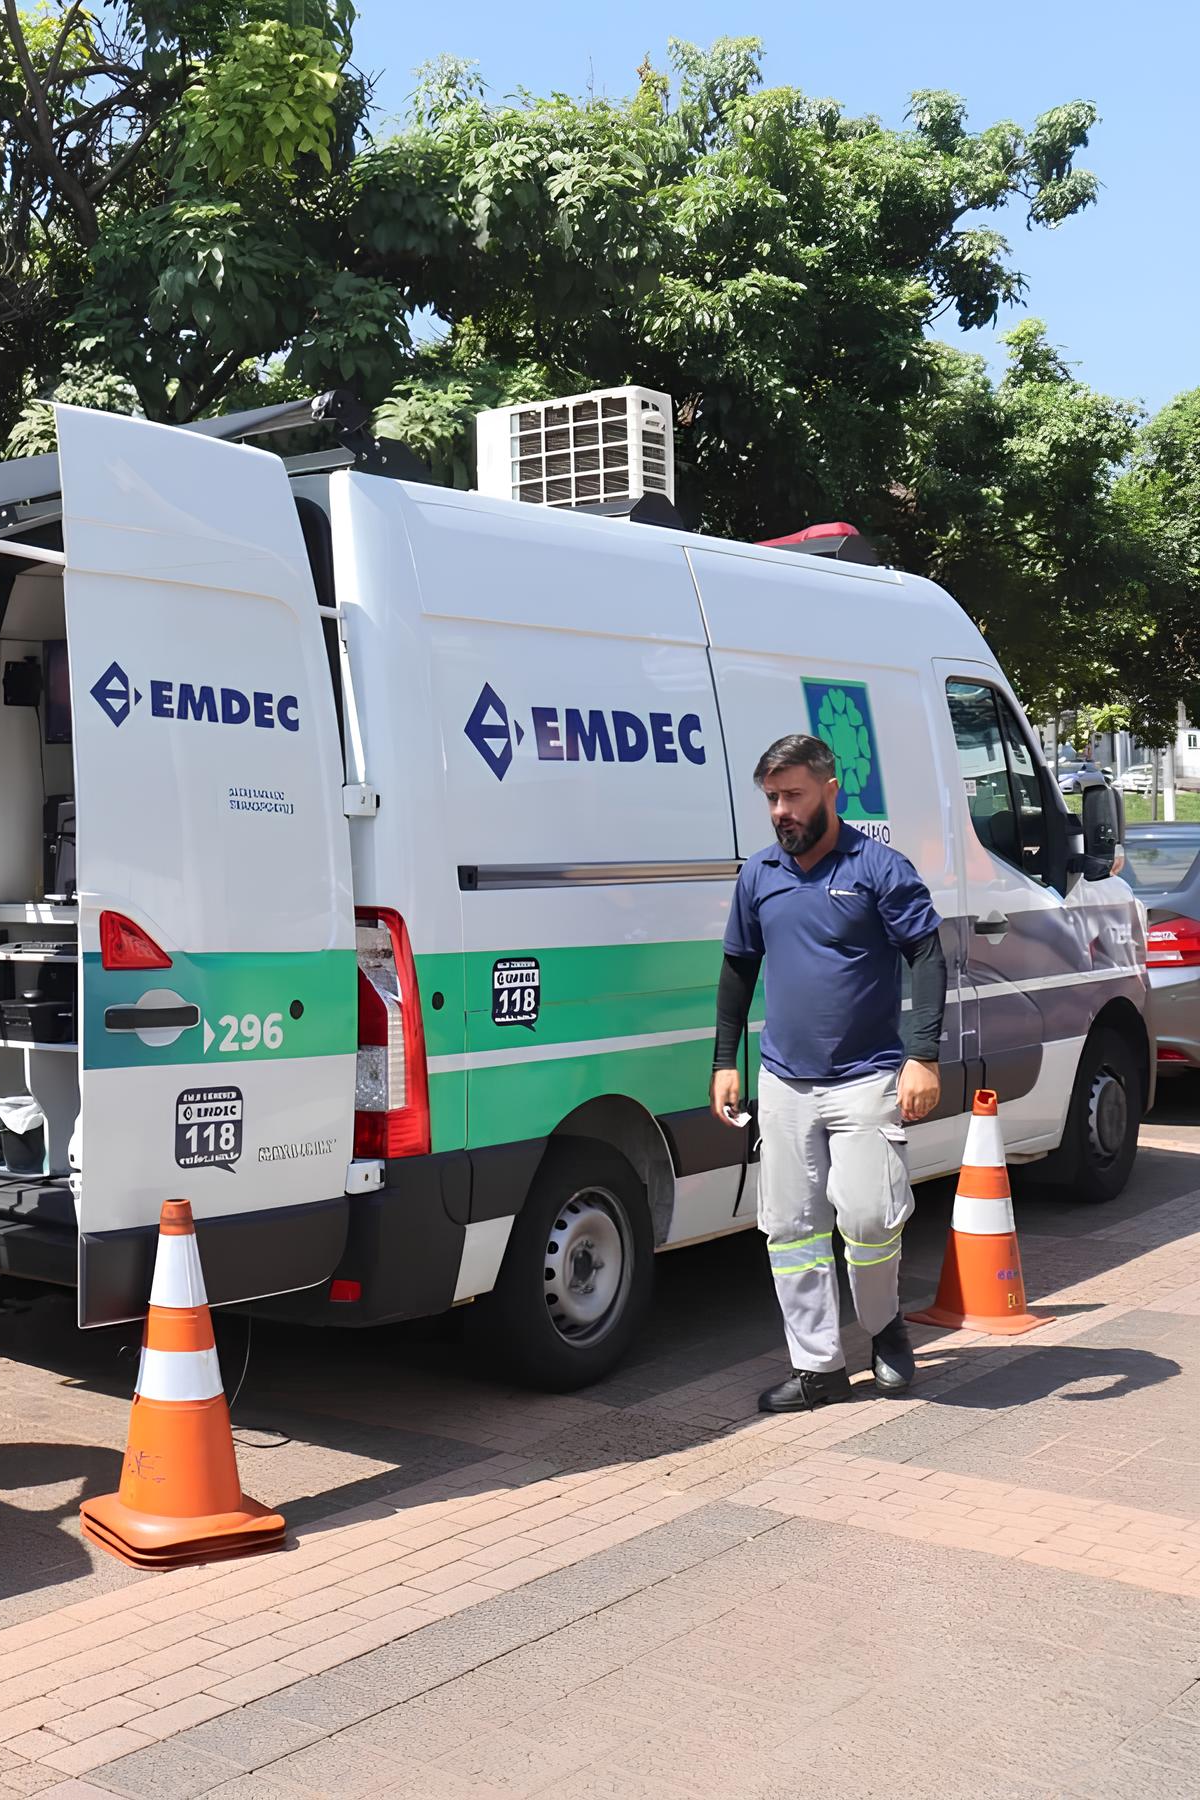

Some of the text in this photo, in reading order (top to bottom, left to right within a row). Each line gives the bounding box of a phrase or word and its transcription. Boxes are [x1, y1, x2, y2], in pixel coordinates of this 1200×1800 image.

[150, 679, 300, 732] EMDEC
[531, 706, 707, 766] EMDEC
[499, 987, 536, 1014] 118
[218, 1012, 284, 1052] 296
[185, 1122, 235, 1154] 118
